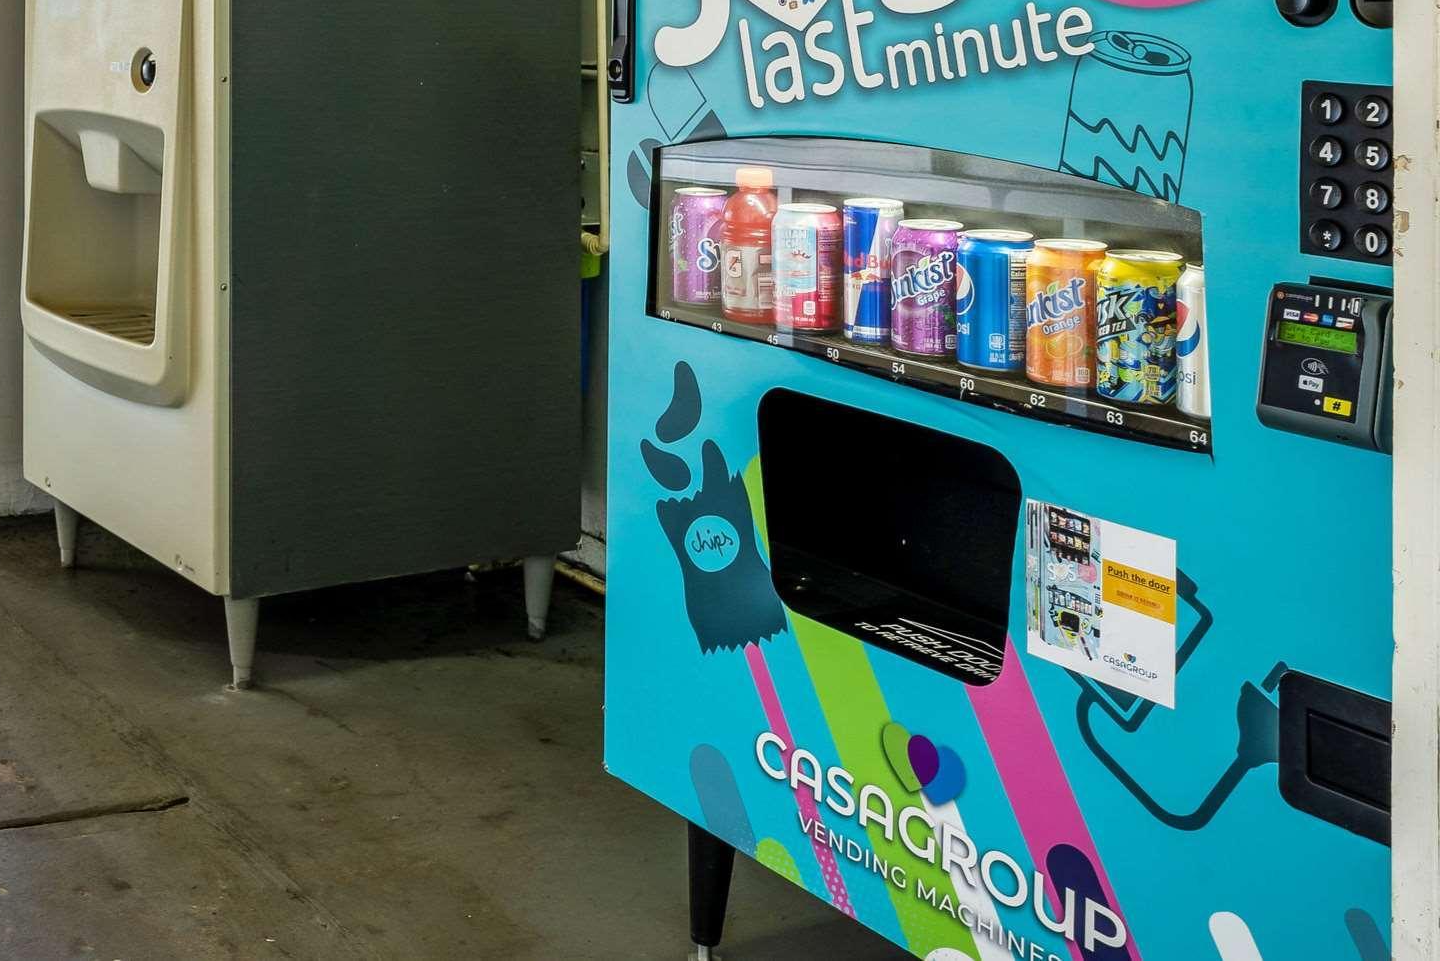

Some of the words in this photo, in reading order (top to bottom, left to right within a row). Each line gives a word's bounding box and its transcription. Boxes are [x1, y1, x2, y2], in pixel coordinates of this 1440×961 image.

[884, 1, 1095, 91] minute
[1320, 99, 1332, 119] 1
[1365, 101, 1380, 122] 2
[1319, 141, 1333, 161] 4
[1365, 146, 1379, 166] 5
[1319, 185, 1333, 205] 7
[1365, 188, 1379, 210] 8
[1364, 232, 1379, 253] 0
[916, 288, 946, 306] Grape
[660, 310, 671, 320] 40
[1285, 310, 1299, 318] VISA
[711, 322, 722, 332] 43
[1042, 315, 1081, 336] Orange
[1111, 320, 1127, 333] TEA
[767, 335, 779, 345] 45
[826, 347, 840, 360] 50
[891, 362, 906, 375] 54
[959, 377, 975, 391] 60
[1308, 380, 1320, 390] Pay
[1029, 393, 1047, 408] 62
[1106, 411, 1124, 426] 63
[1189, 430, 1208, 446] 64
[691, 528, 734, 558] chips
[1107, 565, 1129, 580] Push
[1131, 573, 1147, 585] the
[1148, 579, 1171, 593] door
[854, 621, 880, 632] TO
[875, 631, 960, 663] RETRIEVE
[880, 623, 952, 650] PUSH
[946, 650, 1003, 674] DOO
[1102, 654, 1158, 681] CASAGROUP
[755, 730, 1128, 953] CASAGROUP
[797, 810, 908, 890] VENDING
